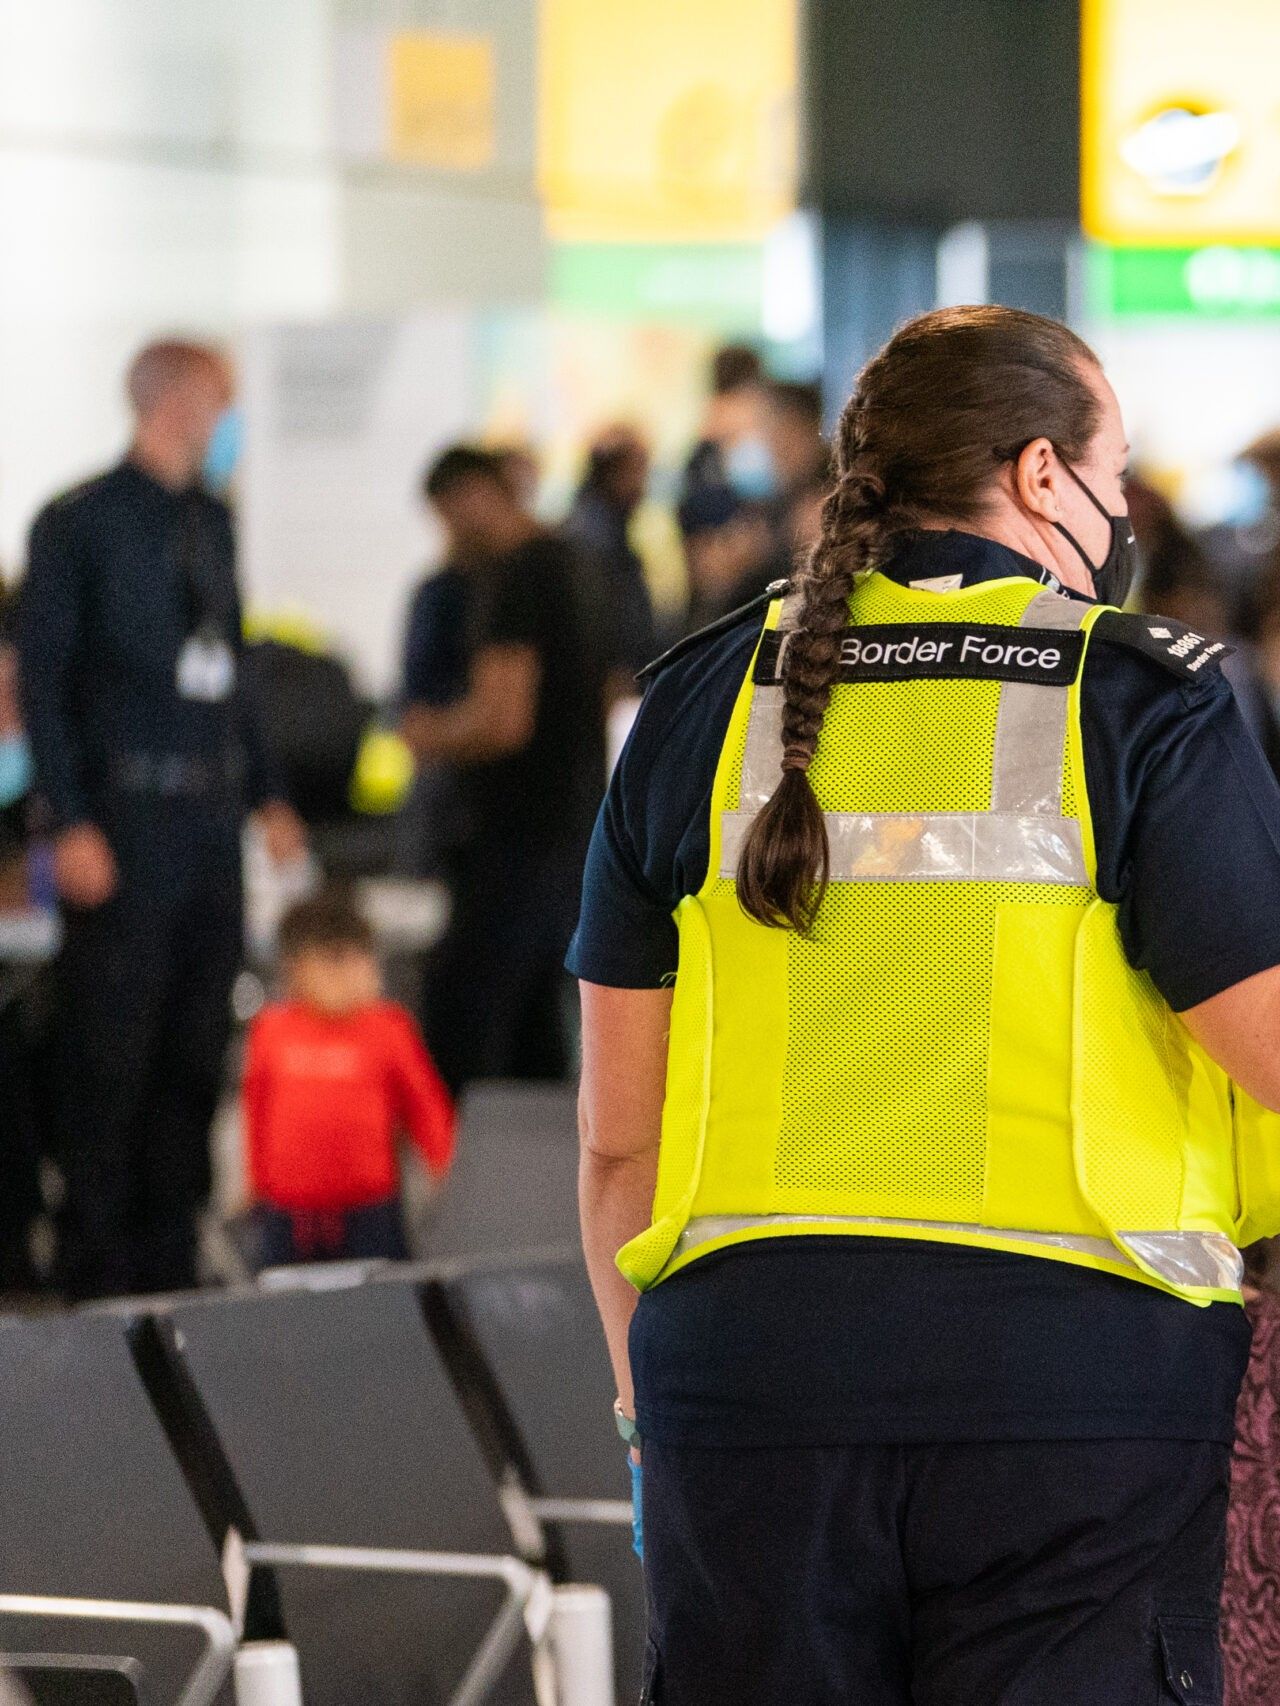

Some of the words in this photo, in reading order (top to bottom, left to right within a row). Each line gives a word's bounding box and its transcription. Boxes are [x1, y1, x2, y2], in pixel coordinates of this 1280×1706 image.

[838, 636, 953, 665] Border
[960, 635, 1061, 669] Force
[1167, 632, 1205, 657] 18861
